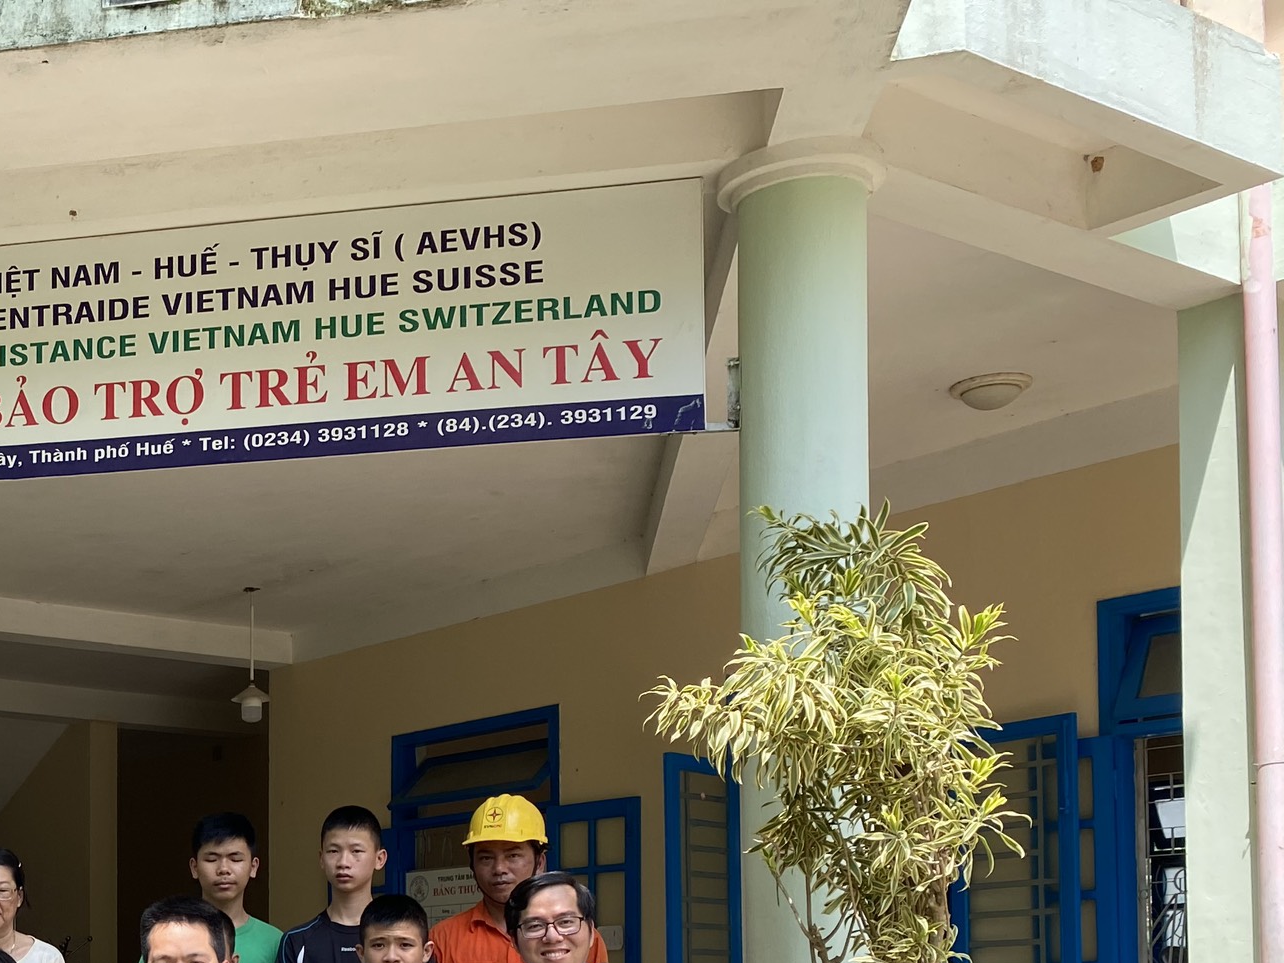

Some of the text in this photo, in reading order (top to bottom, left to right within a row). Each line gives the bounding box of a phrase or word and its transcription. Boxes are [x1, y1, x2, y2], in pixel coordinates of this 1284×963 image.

[51, 261, 120, 289] NAM
[154, 243, 220, 279] HUẾ
[251, 240, 339, 271] THỤY
[350, 230, 383, 261] SĨ
[162, 280, 314, 316] VIETNAM
[329, 273, 399, 301] HUE
[413, 260, 544, 293] SUISSE
[148, 320, 300, 354] VIETNAM
[316, 312, 385, 340] HUE
[399, 289, 661, 333] SWITZERLAND
[94, 368, 205, 425] TRỢ
[220, 350, 328, 410] TRẺ
[343, 356, 431, 401] EM
[446, 348, 526, 393] AN
[542, 329, 663, 385] TÂY
[29, 447, 87, 464] Thành
[94, 441, 130, 462] phố
[136, 438, 175, 456] Huế
[199, 436, 235, 451] Tel:
[243, 430, 310, 450] (0234)
[318, 422, 409, 443] 3931128
[560, 404, 657, 425] 3931129
